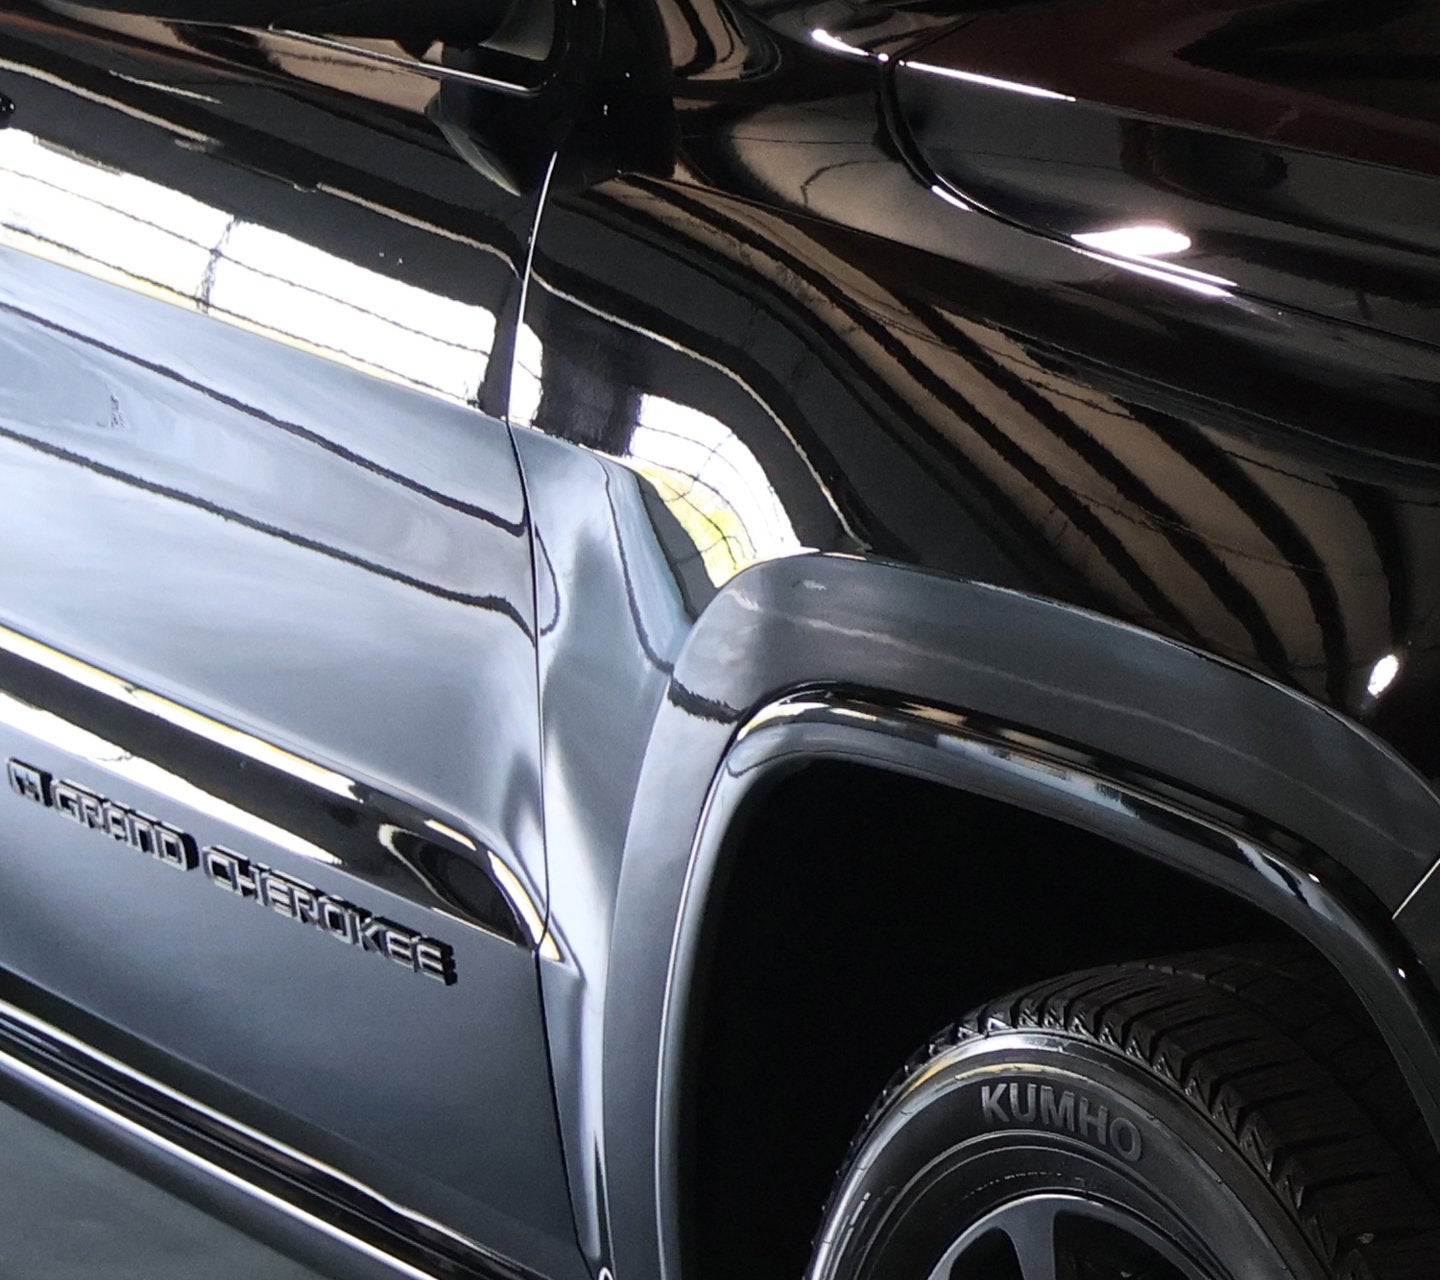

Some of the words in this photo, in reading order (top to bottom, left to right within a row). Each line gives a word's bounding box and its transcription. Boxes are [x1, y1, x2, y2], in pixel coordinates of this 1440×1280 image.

[51, 777, 200, 872] GRAND
[202, 844, 459, 987] CHEROKEE
[979, 1081, 1144, 1164] KUMHO
